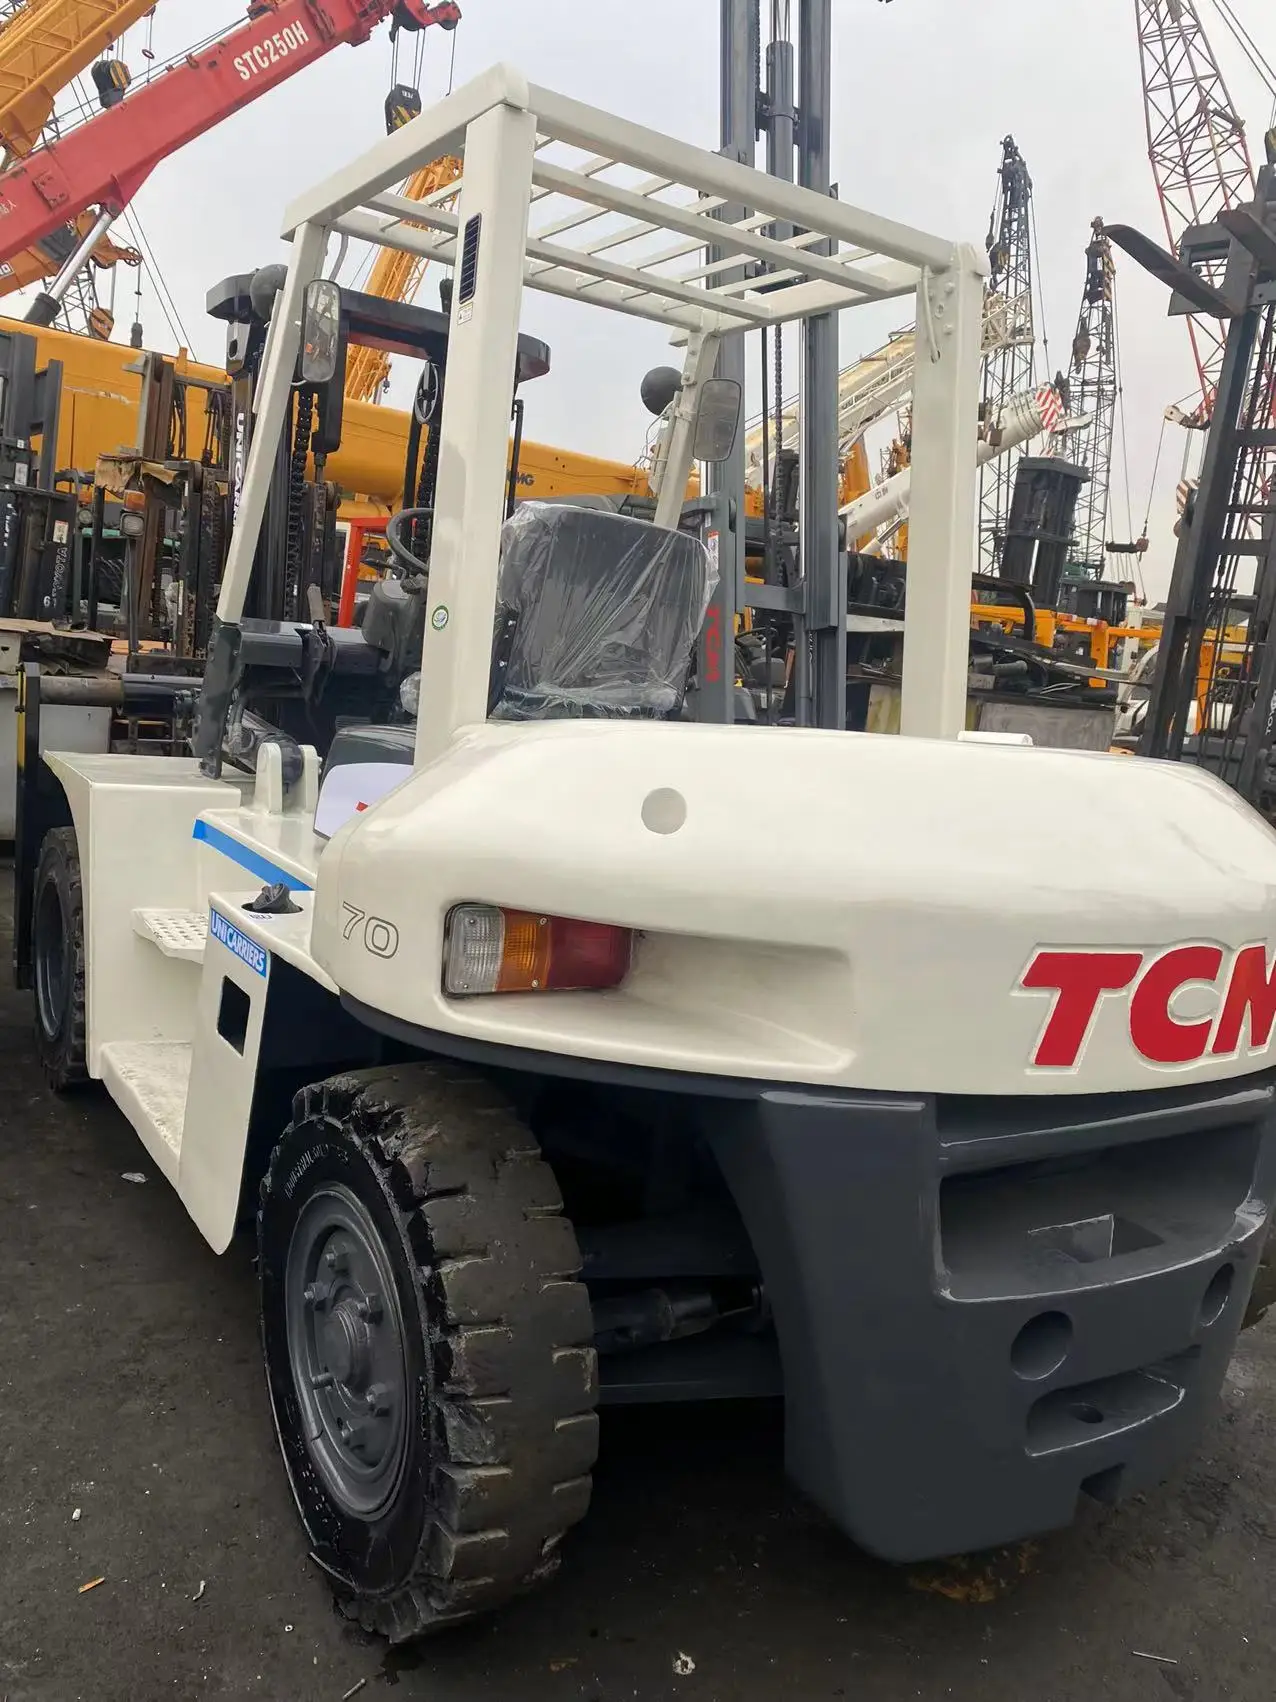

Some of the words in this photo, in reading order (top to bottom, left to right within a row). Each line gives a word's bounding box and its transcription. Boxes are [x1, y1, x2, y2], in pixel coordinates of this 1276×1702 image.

[233, 20, 309, 80] STC250H
[211, 910, 266, 972] UNICARRIERS
[342, 900, 399, 959] 70
[1021, 945, 1276, 1067] TCM
